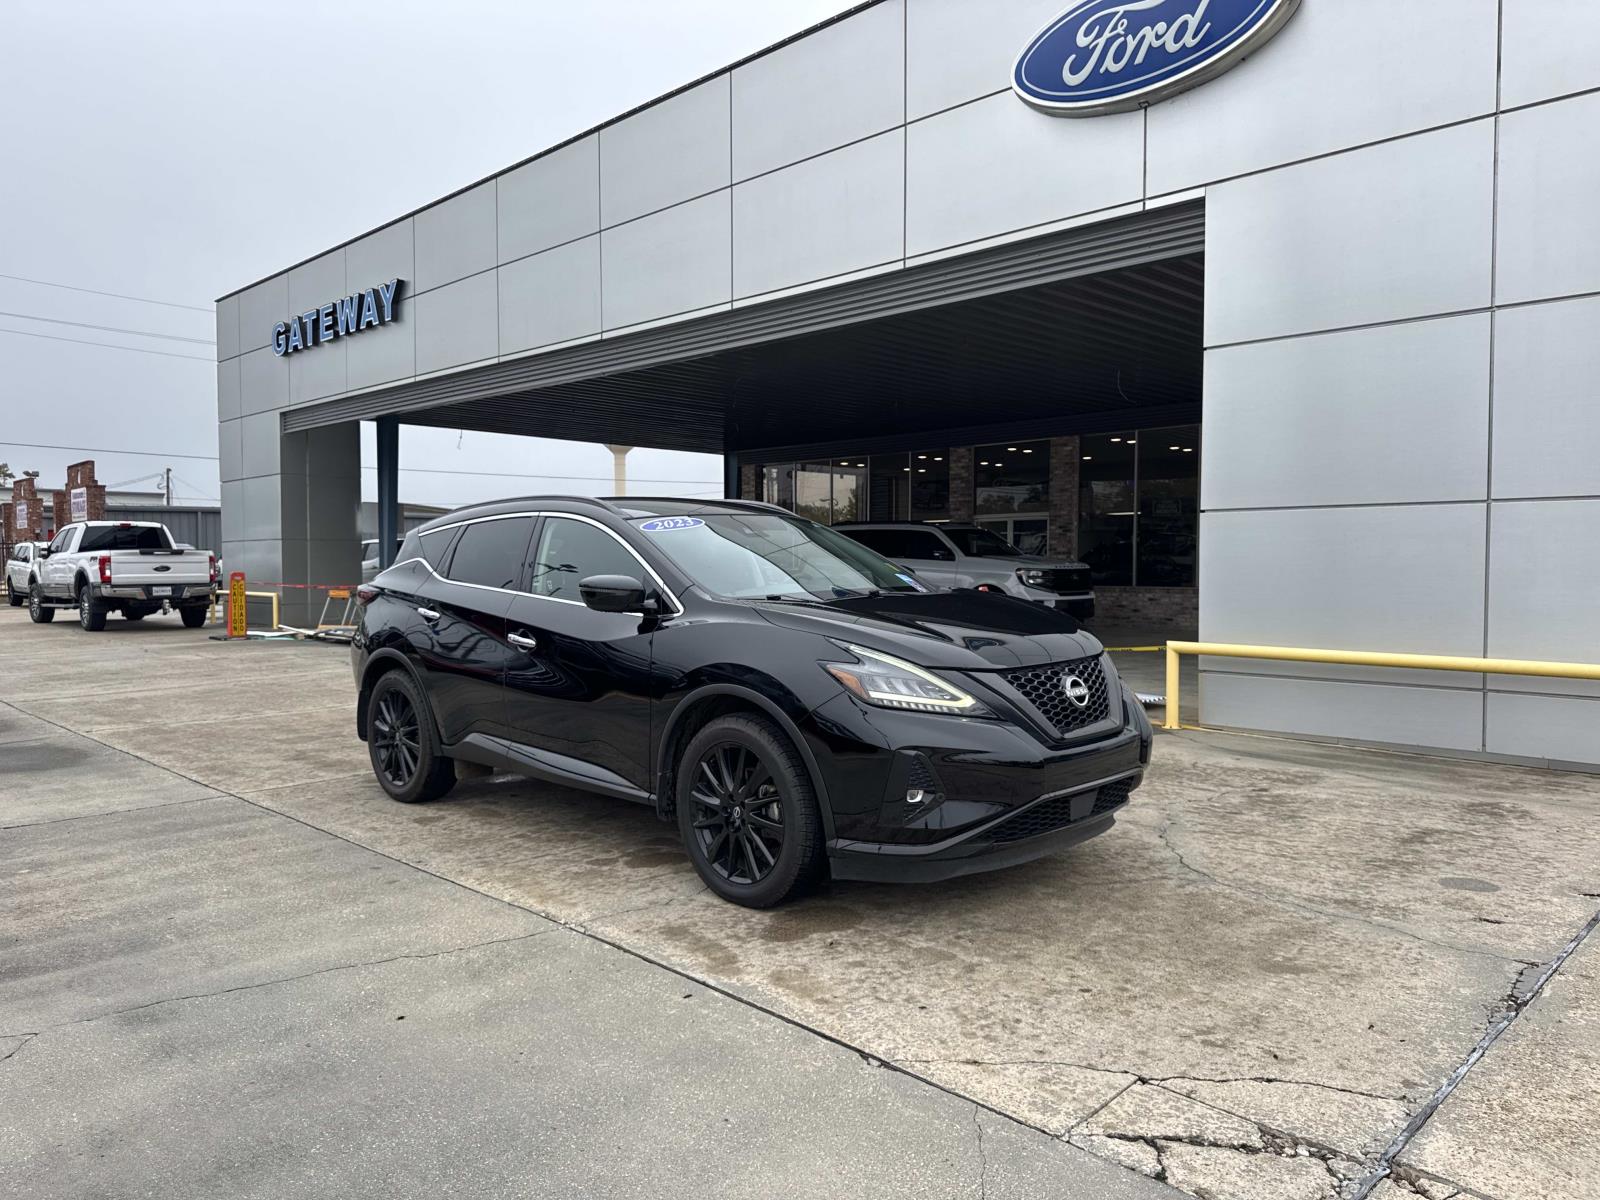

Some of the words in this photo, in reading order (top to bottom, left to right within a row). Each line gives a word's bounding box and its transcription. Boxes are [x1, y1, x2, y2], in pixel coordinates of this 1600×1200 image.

[1062, 0, 1211, 87] Ford
[272, 279, 398, 357] GATEWAY
[654, 519, 694, 530] 2023
